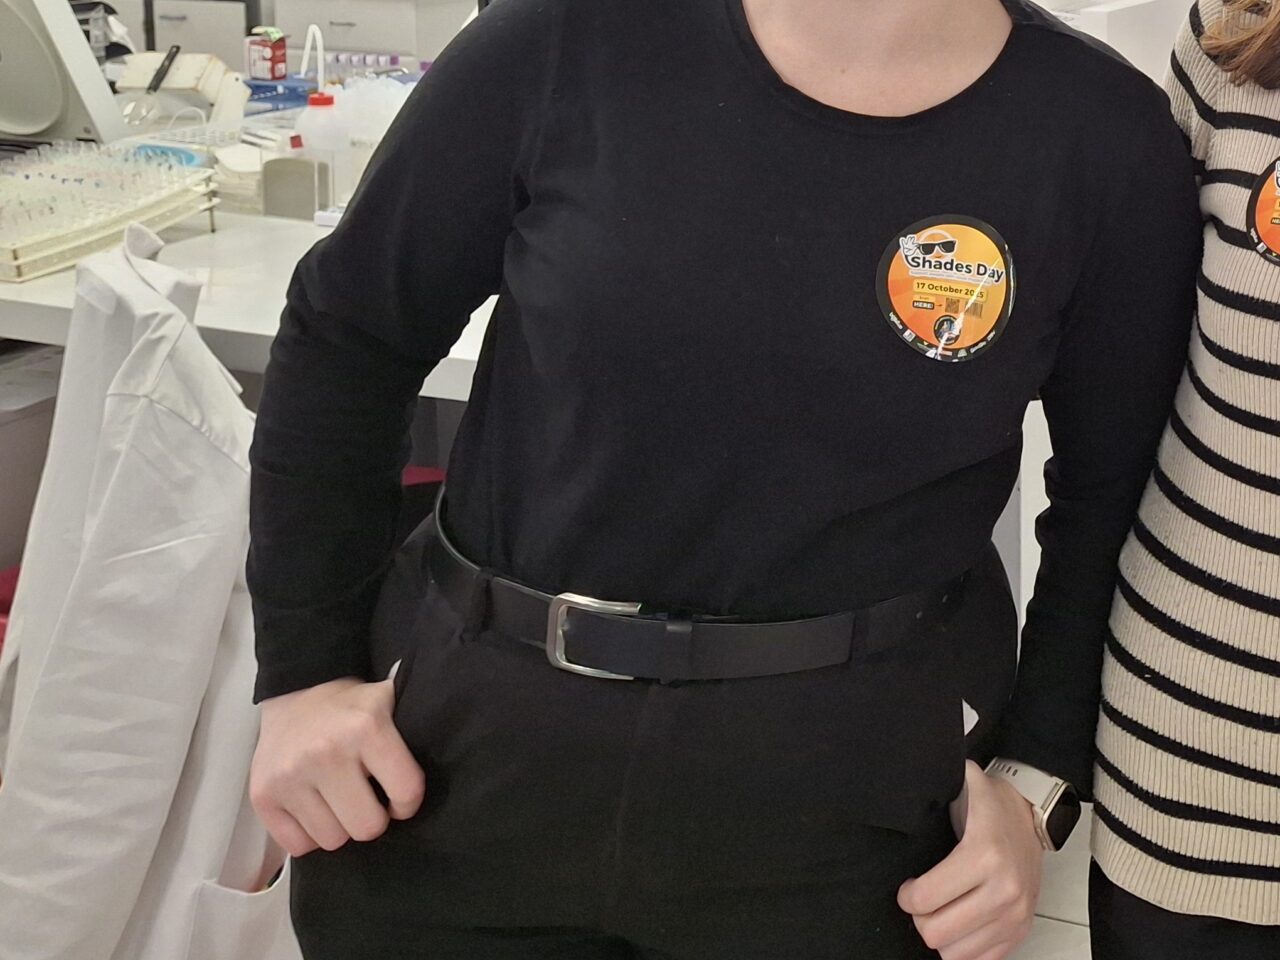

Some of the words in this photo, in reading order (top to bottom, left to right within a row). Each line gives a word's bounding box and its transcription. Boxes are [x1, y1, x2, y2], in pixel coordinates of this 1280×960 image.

[907, 256, 972, 274] Shades
[976, 263, 1004, 283] Day
[927, 283, 962, 294] October
